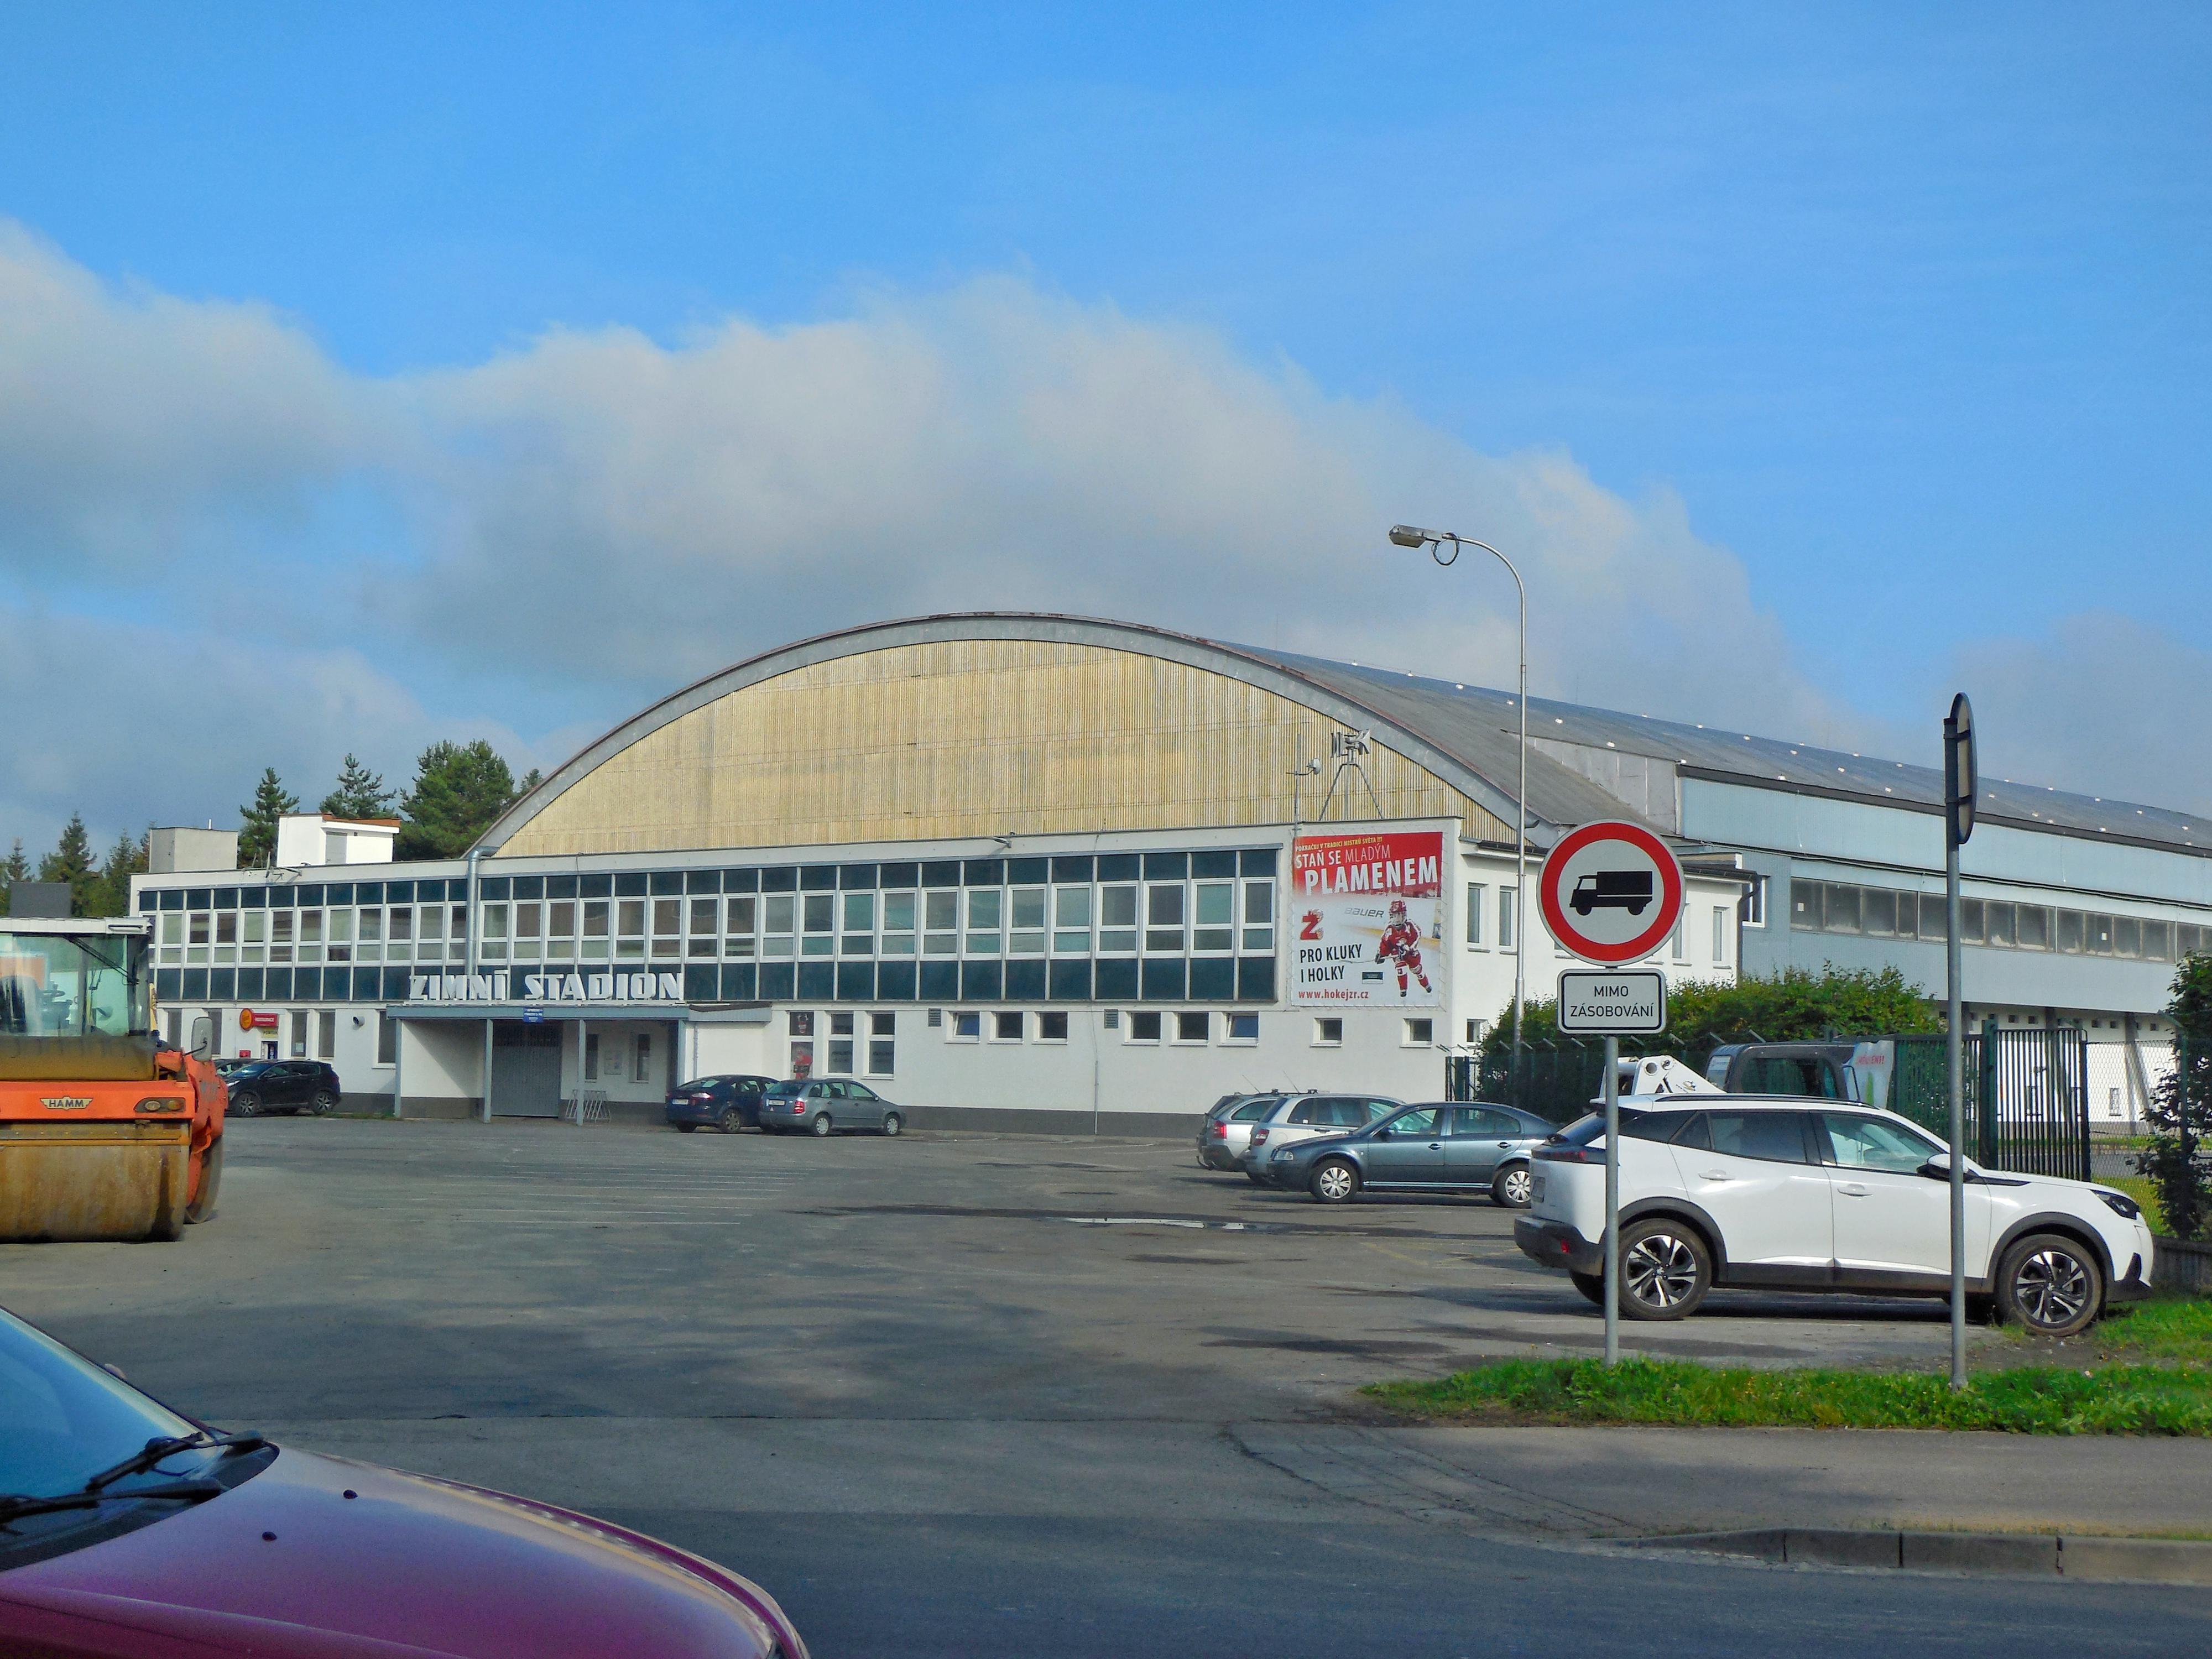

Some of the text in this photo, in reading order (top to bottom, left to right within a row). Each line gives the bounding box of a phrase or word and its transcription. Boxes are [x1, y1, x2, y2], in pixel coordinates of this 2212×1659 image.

[1344, 837, 1361, 846] MISTRŮ
[1295, 843, 1391, 869] STAŇ SE MLADÝM
[1304, 855, 1438, 896] PLAMENEM
[1300, 943, 1362, 963] PRO KLUKY
[1301, 966, 1345, 983] I HOLKY
[409, 969, 685, 1001] ZIMNÍ STADION
[1594, 985, 1629, 997] MIMO
[1298, 988, 1369, 1001] www.hokejzr.cz
[1571, 1002, 1655, 1017] ZÁSOBOVÁNÍ
